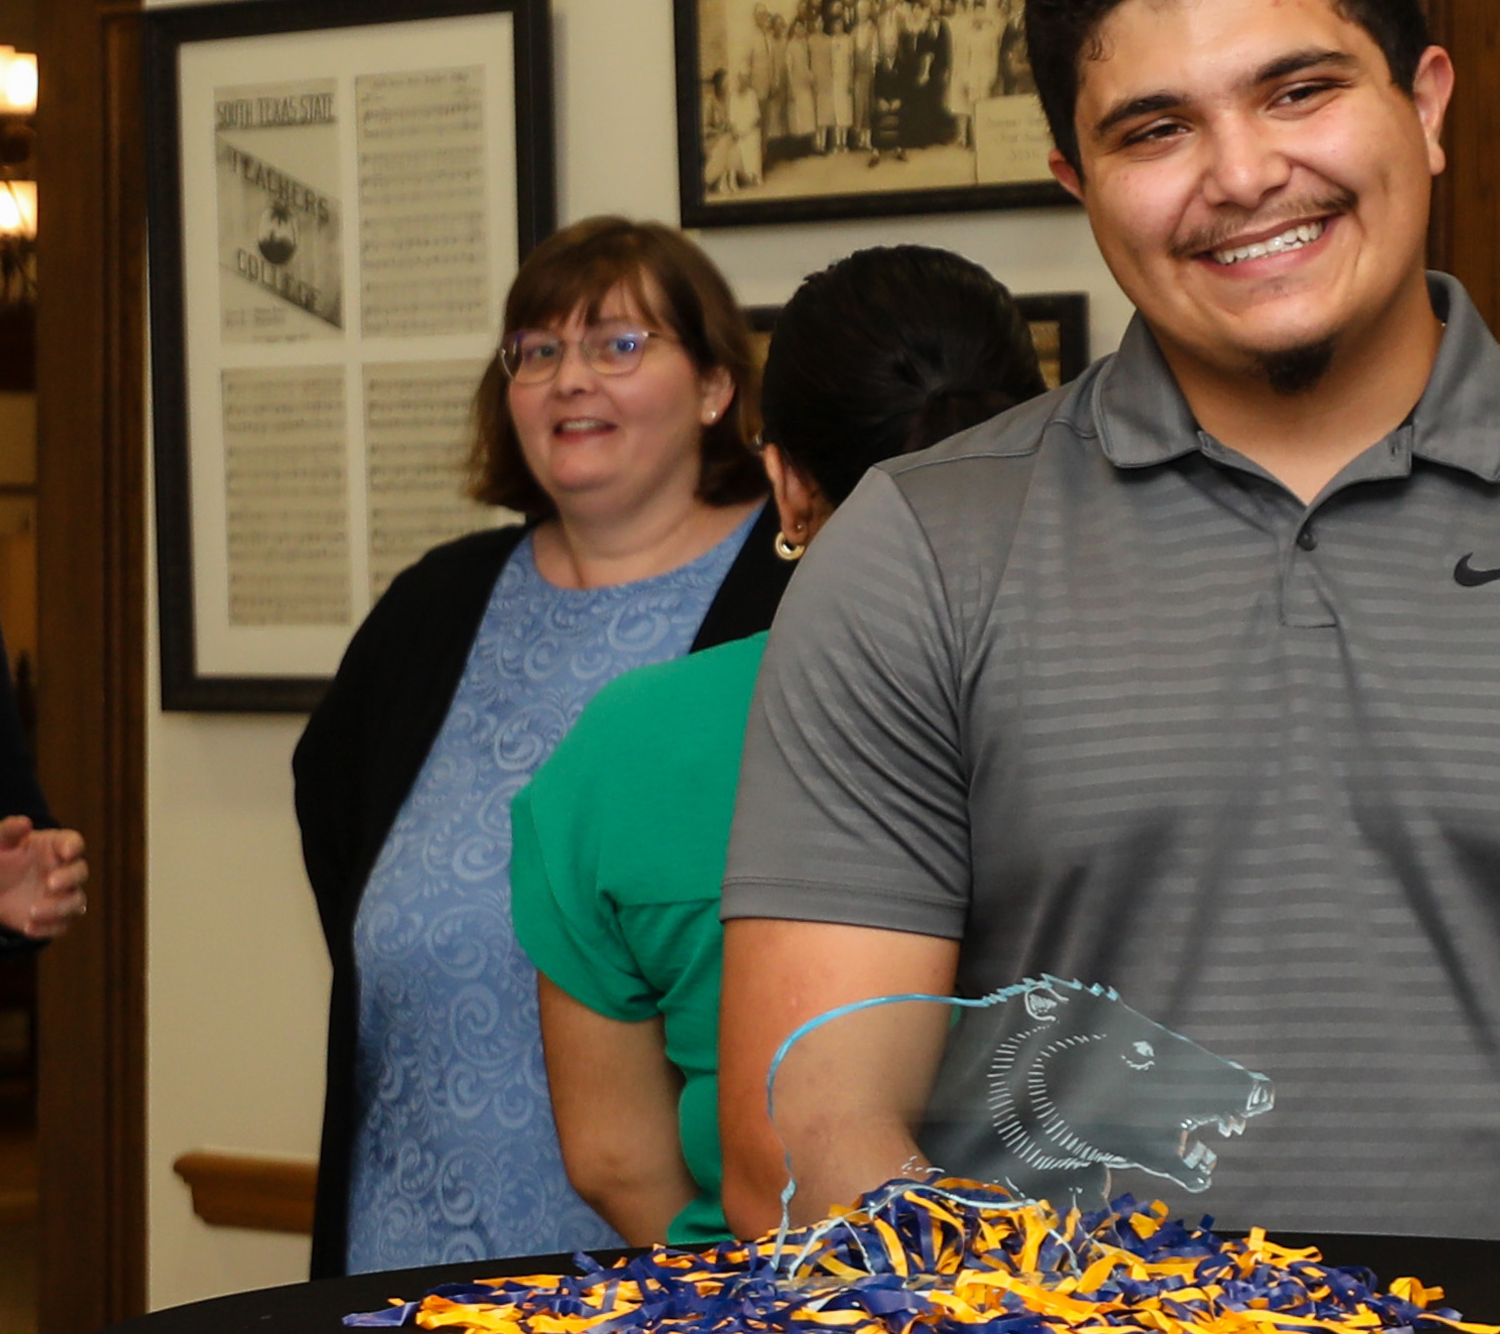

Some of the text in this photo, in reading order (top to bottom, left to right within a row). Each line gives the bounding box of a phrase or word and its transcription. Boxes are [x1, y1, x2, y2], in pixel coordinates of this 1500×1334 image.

[215, 92, 335, 129] SOUTH TEXAS STATE
[227, 146, 329, 229] TEACHERS
[237, 248, 320, 310] COLLEGE
